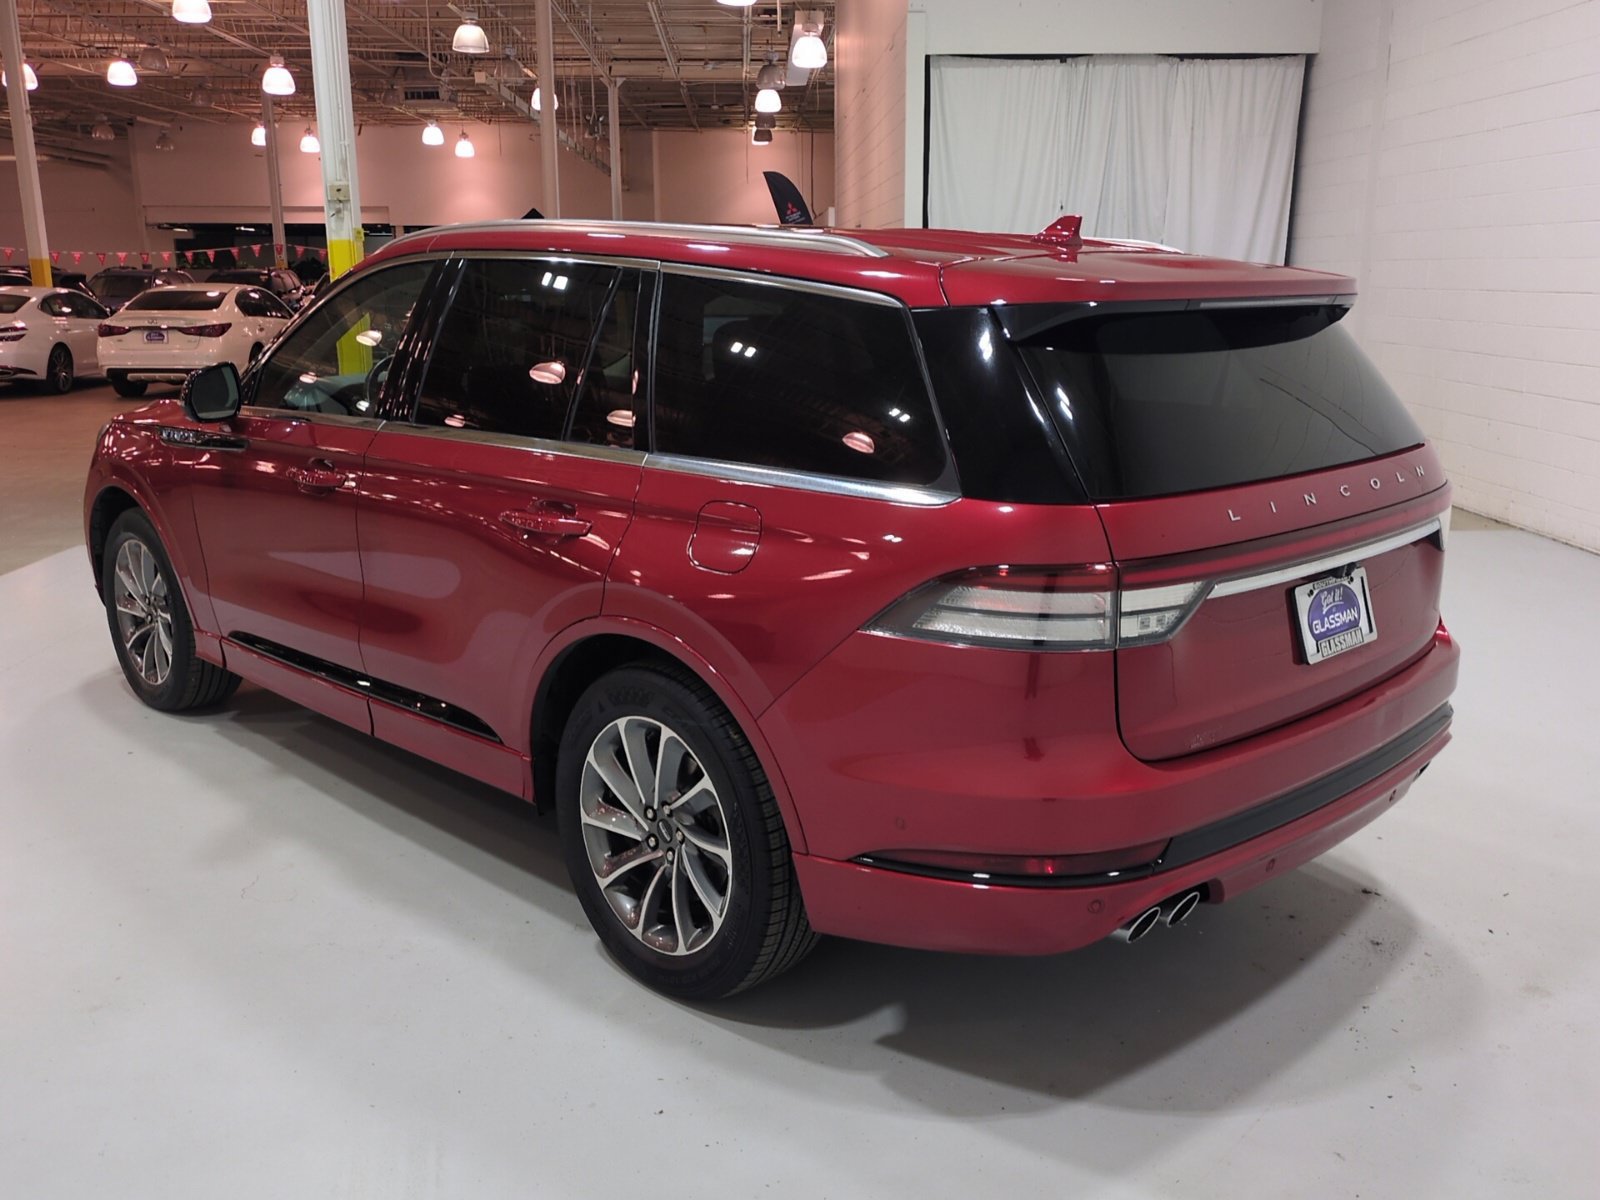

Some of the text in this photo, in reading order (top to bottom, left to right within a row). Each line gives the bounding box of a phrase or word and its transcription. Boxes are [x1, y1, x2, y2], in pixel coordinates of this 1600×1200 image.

[1227, 465, 1425, 522] LINCOLN
[1312, 607, 1358, 634] GLASSMAN
[1321, 628, 1362, 657] GLASSMAN
